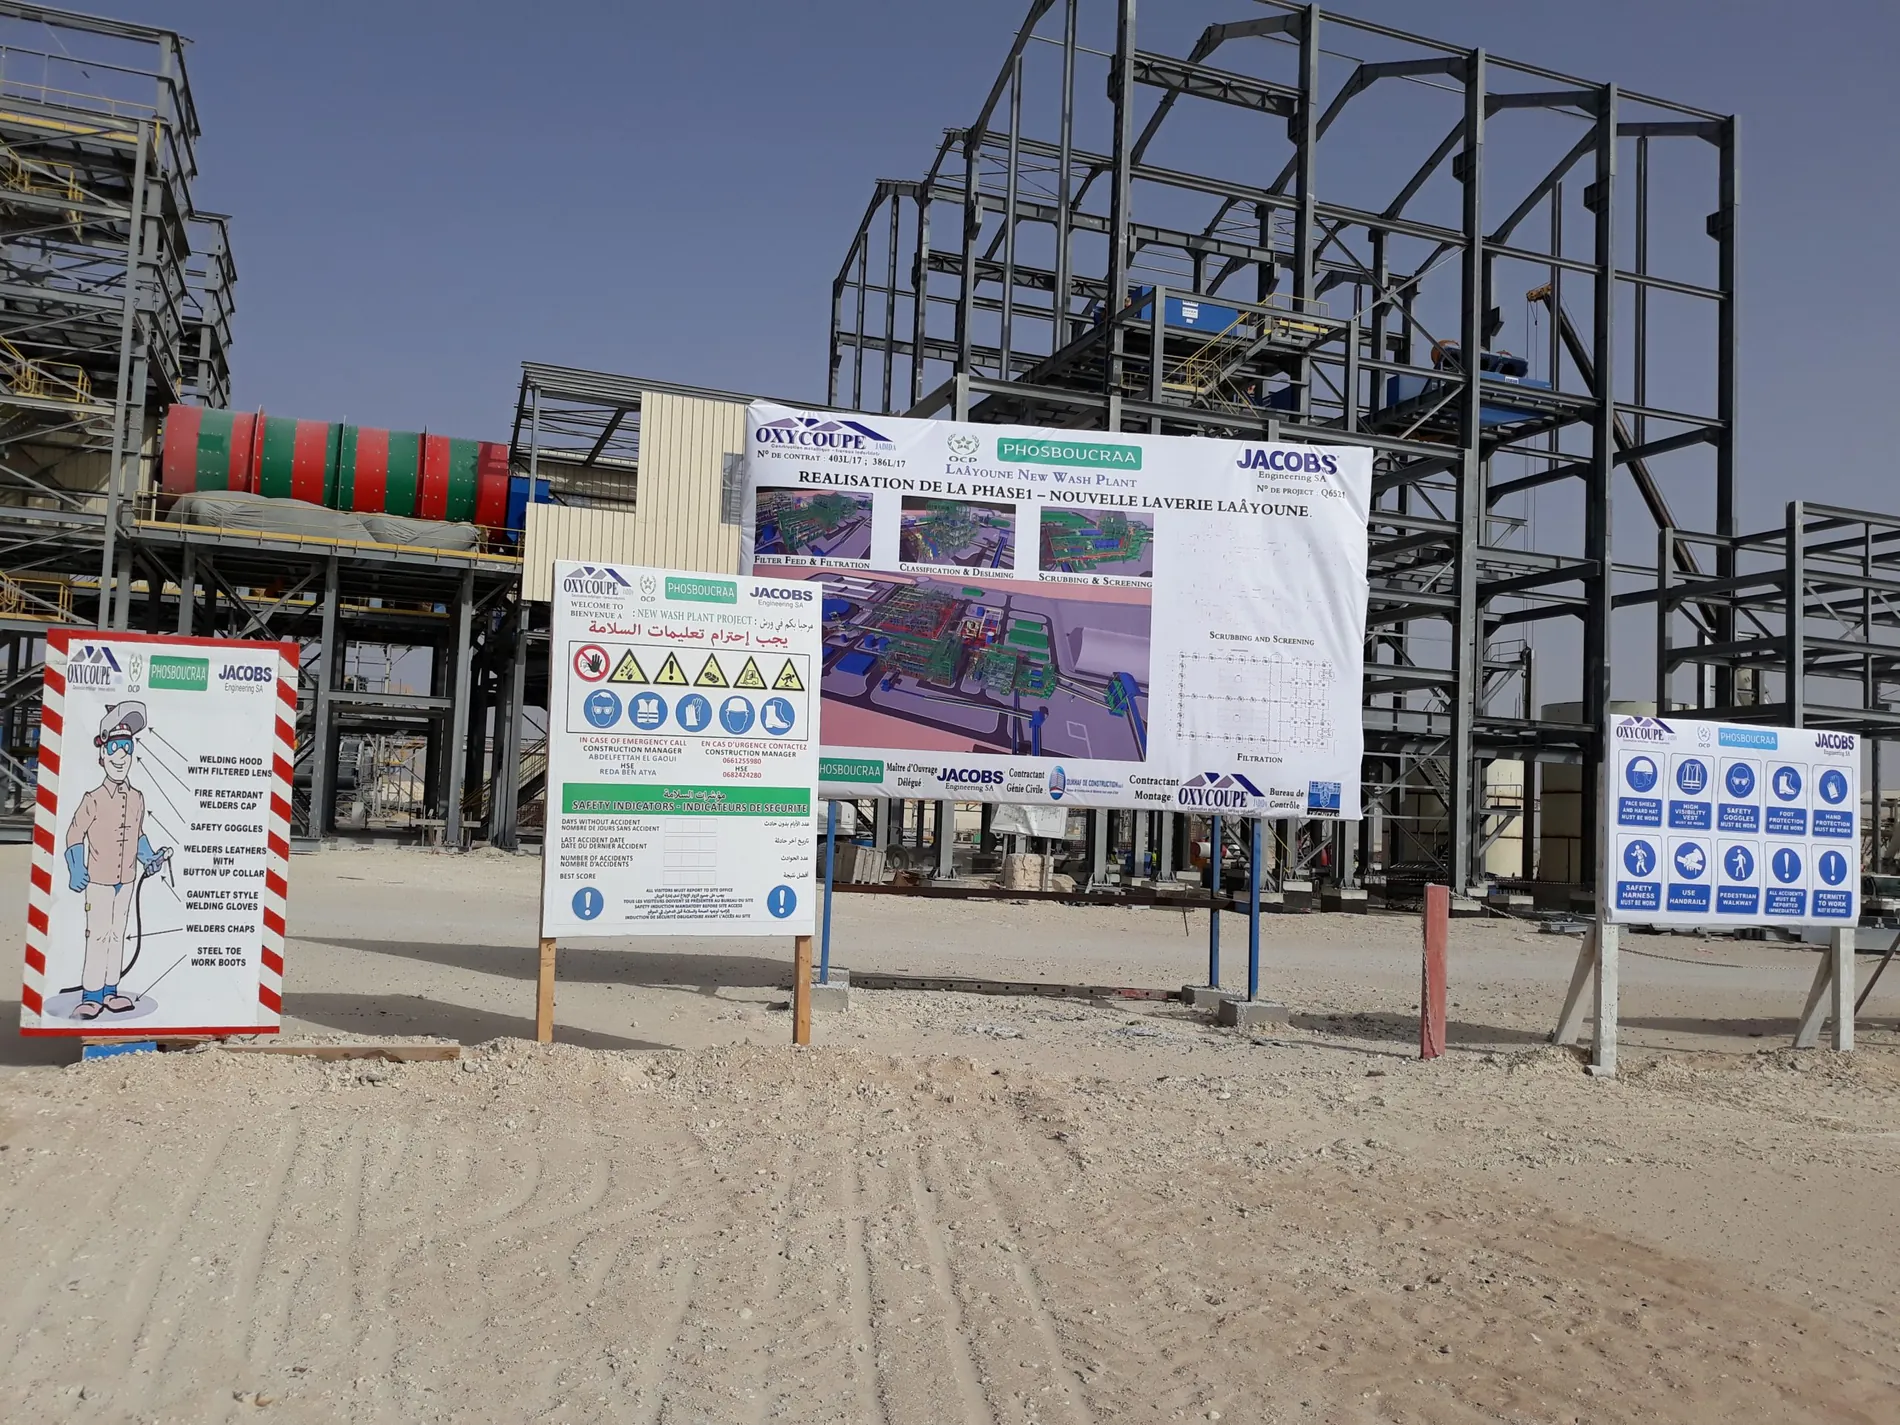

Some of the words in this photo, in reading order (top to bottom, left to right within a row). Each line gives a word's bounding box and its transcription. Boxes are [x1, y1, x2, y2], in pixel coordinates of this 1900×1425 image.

[755, 427, 866, 449] OXYCOUPE
[1003, 443, 1136, 463] PHOSBOUCRAA
[784, 453, 820, 462] CONTRAT
[828, 455, 862, 464] 403L/17
[872, 457, 906, 468] 386L/17
[1236, 448, 1338, 475] JACOBS
[1052, 471, 1091, 484] WASH
[1096, 474, 1137, 488] PLANT
[1258, 471, 1312, 483] Engineering
[1314, 474, 1326, 482] SA
[798, 470, 914, 491] REALISATION
[919, 480, 942, 493] DE
[946, 482, 967, 495] LA
[971, 484, 1032, 500] PHASE1
[1049, 490, 1138, 507] NOUVELLE
[1141, 496, 1213, 511] LAVERIE
[1282, 488, 1314, 496] PROJECT
[754, 555, 782, 564] FILTER
[785, 556, 806, 565] FEED
[809, 557, 817, 566] &
[820, 557, 870, 569] FILTRATION
[900, 563, 959, 575] CLASSIFICATION
[1038, 573, 1088, 585] SCRUBBING
[1090, 577, 1099, 585] &
[563, 578, 619, 596] OXYCOUPE
[668, 582, 735, 598] PHOSBOUCRAA
[749, 586, 813, 601] JACOBS
[570, 601, 610, 610] WELCOME
[570, 610, 615, 619] BIENVENUE
[637, 609, 657, 618] NEW
[660, 610, 684, 621] WASH
[687, 611, 714, 623] PLANT
[717, 614, 752, 626] PROJECT
[588, 620, 641, 635] السلامة
[647, 625, 704, 642] تعليمات
[711, 629, 749, 646] إحترام
[755, 635, 788, 649] يجب
[67, 663, 110, 685] OXYCOUPE
[150, 664, 206, 681] PHOSBOUCRAA
[218, 664, 272, 682] JACOBS
[224, 682, 254, 693] Engineering
[254, 683, 263, 693] SA
[1616, 725, 1663, 741] OXYCOUPE
[1720, 732, 1776, 746] PHOSBOUCRAA
[622, 738, 668, 746] EMERGENCY
[728, 741, 766, 749] D'URGENCE
[768, 742, 807, 750] CONTACTEZ
[1815, 733, 1854, 750] JACOBS
[583, 745, 642, 753] CONSTRUCTION
[199, 755, 237, 765] WELDING
[239, 757, 263, 765] HOOD
[1237, 752, 1283, 763] FILTRATION
[187, 766, 209, 775] WITH
[211, 767, 250, 776] FILTERED
[252, 769, 272, 777] LENS
[819, 763, 881, 776] HOSBOUCRAA
[1009, 767, 1045, 779] Contractant
[936, 768, 1004, 784] JACOBS
[1129, 774, 1179, 786] Contractant
[945, 783, 983, 792] Engineering
[1007, 783, 1024, 793] Génie
[1025, 784, 1043, 794] Civile
[1269, 788, 1295, 797] Bureau
[194, 789, 213, 797] FIRE
[215, 789, 264, 799] RETARDANT
[663, 789, 693, 799] السلامة
[1178, 787, 1248, 808] OXYCOUPE
[199, 801, 238, 810] WELDERS
[240, 802, 257, 810] CAP
[572, 801, 611, 810] SAFETY
[613, 801, 674, 811] INDICATORS
[683, 802, 747, 812] INDICATEURS
[750, 804, 761, 812] DE
[764, 804, 807, 813] SECURITE
[1269, 800, 1299, 810] Contrôle
[1726, 807, 1752, 815] SAFETY
[190, 823, 222, 831] SAFETY
[224, 824, 263, 833] GOGGLES
[183, 845, 223, 853] WELDERS
[225, 846, 267, 855] LEATHERS
[213, 857, 234, 865] WITH
[183, 868, 217, 876] BUTTON
[232, 869, 265, 877] COLLAR
[187, 890, 231, 899] GAUNTLET
[233, 891, 259, 899] STYLE
[186, 902, 224, 910] WELDING
[225, 903, 258, 911] GLOVES
[186, 924, 226, 933] WELDERS
[227, 925, 255, 933] CHAPS
[197, 947, 223, 955] STEEL
[225, 947, 242, 955] TOE
[191, 959, 216, 967] WORK
[218, 959, 246, 967] BOOTS
